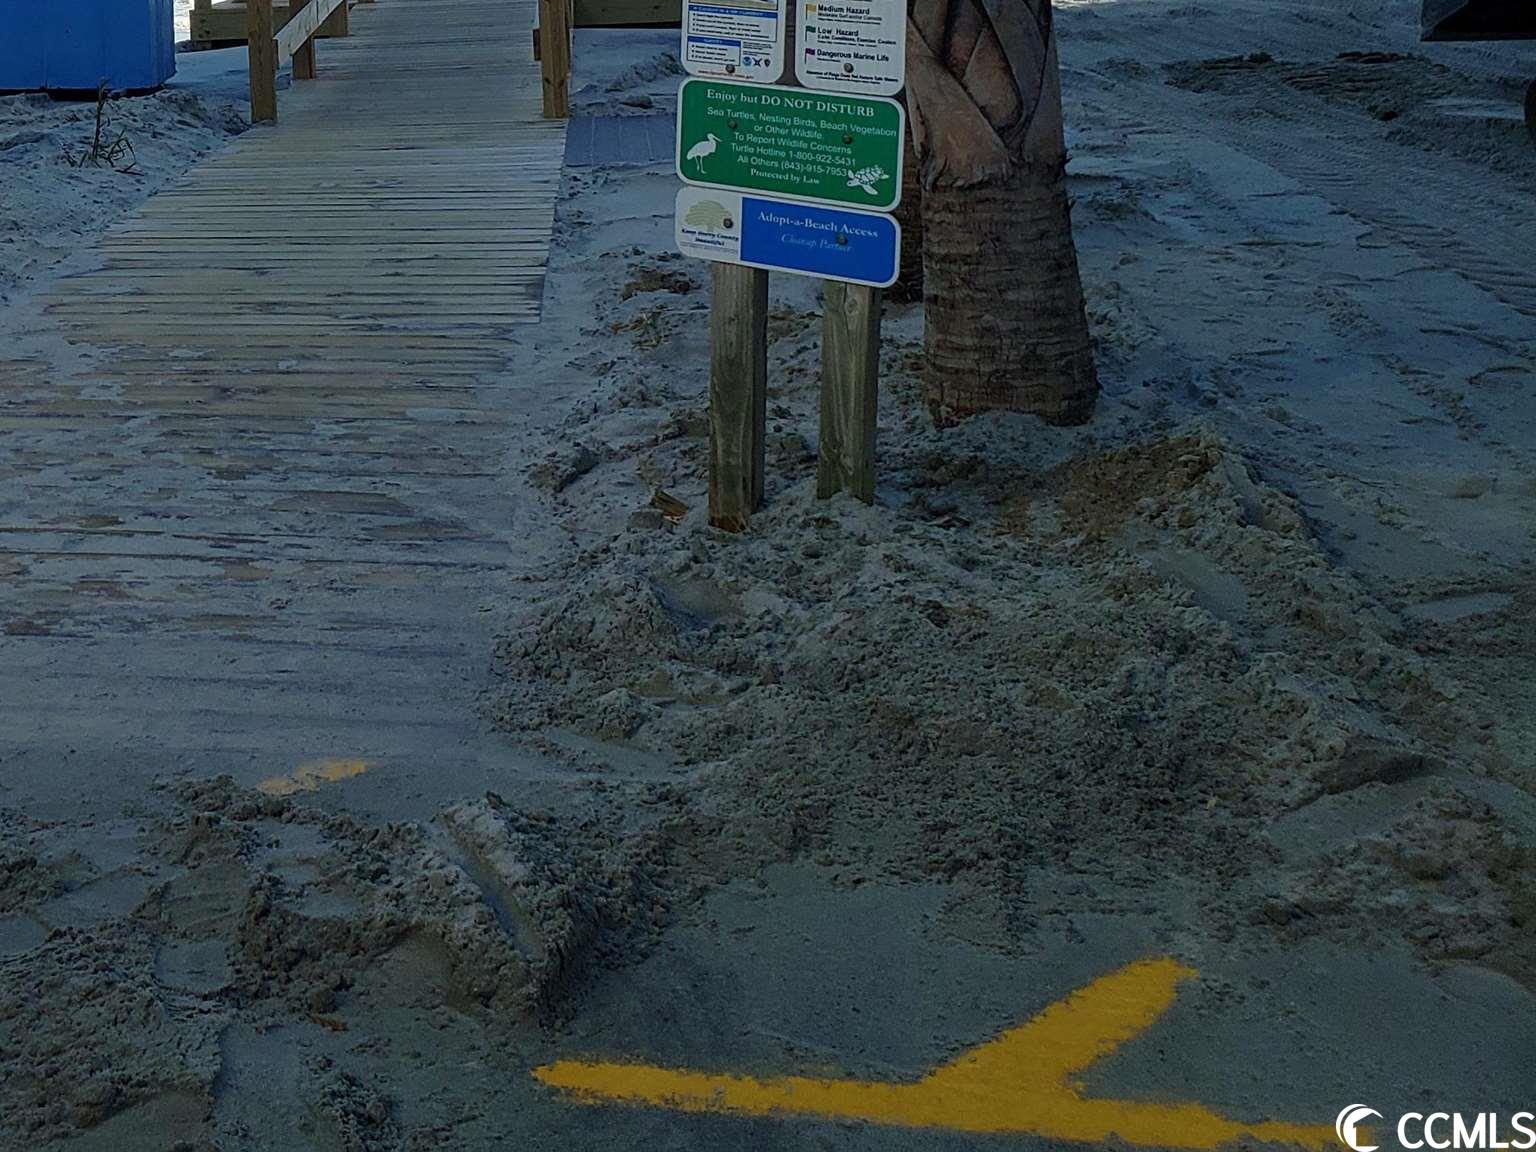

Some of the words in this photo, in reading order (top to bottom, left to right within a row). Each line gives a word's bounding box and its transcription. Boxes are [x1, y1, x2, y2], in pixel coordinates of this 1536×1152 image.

[818, 4, 844, 13] Medium
[846, 6, 870, 15] Hazard
[836, 28, 859, 37] Hazard
[817, 48, 851, 59] Dangerous
[853, 52, 875, 60] Marine
[877, 53, 889, 61] Life
[707, 89, 737, 104] Enjoy
[740, 93, 758, 104] but
[761, 95, 781, 105] DO
[783, 98, 814, 110] NOT
[816, 101, 875, 116] DISTURB
[707, 107, 724, 116] Sea
[759, 113, 791, 125] Nesting
[820, 120, 848, 131] Beach
[850, 123, 897, 137] Vegetation
[765, 125, 789, 135] Other
[731, 142, 754, 153] Turtle
[756, 147, 786, 157] Hotline
[734, 132, 744, 141] To
[746, 133, 775, 144] Report
[777, 137, 808, 148] Wildlife
[810, 141, 851, 154] Concerns
[737, 155, 749, 163] All
[750, 156, 778, 168] Others
[751, 168, 789, 180] Protected
[790, 172, 800, 183] by
[758, 211, 838, 232] Adopt-a-Beach
[840, 223, 878, 238] Access
